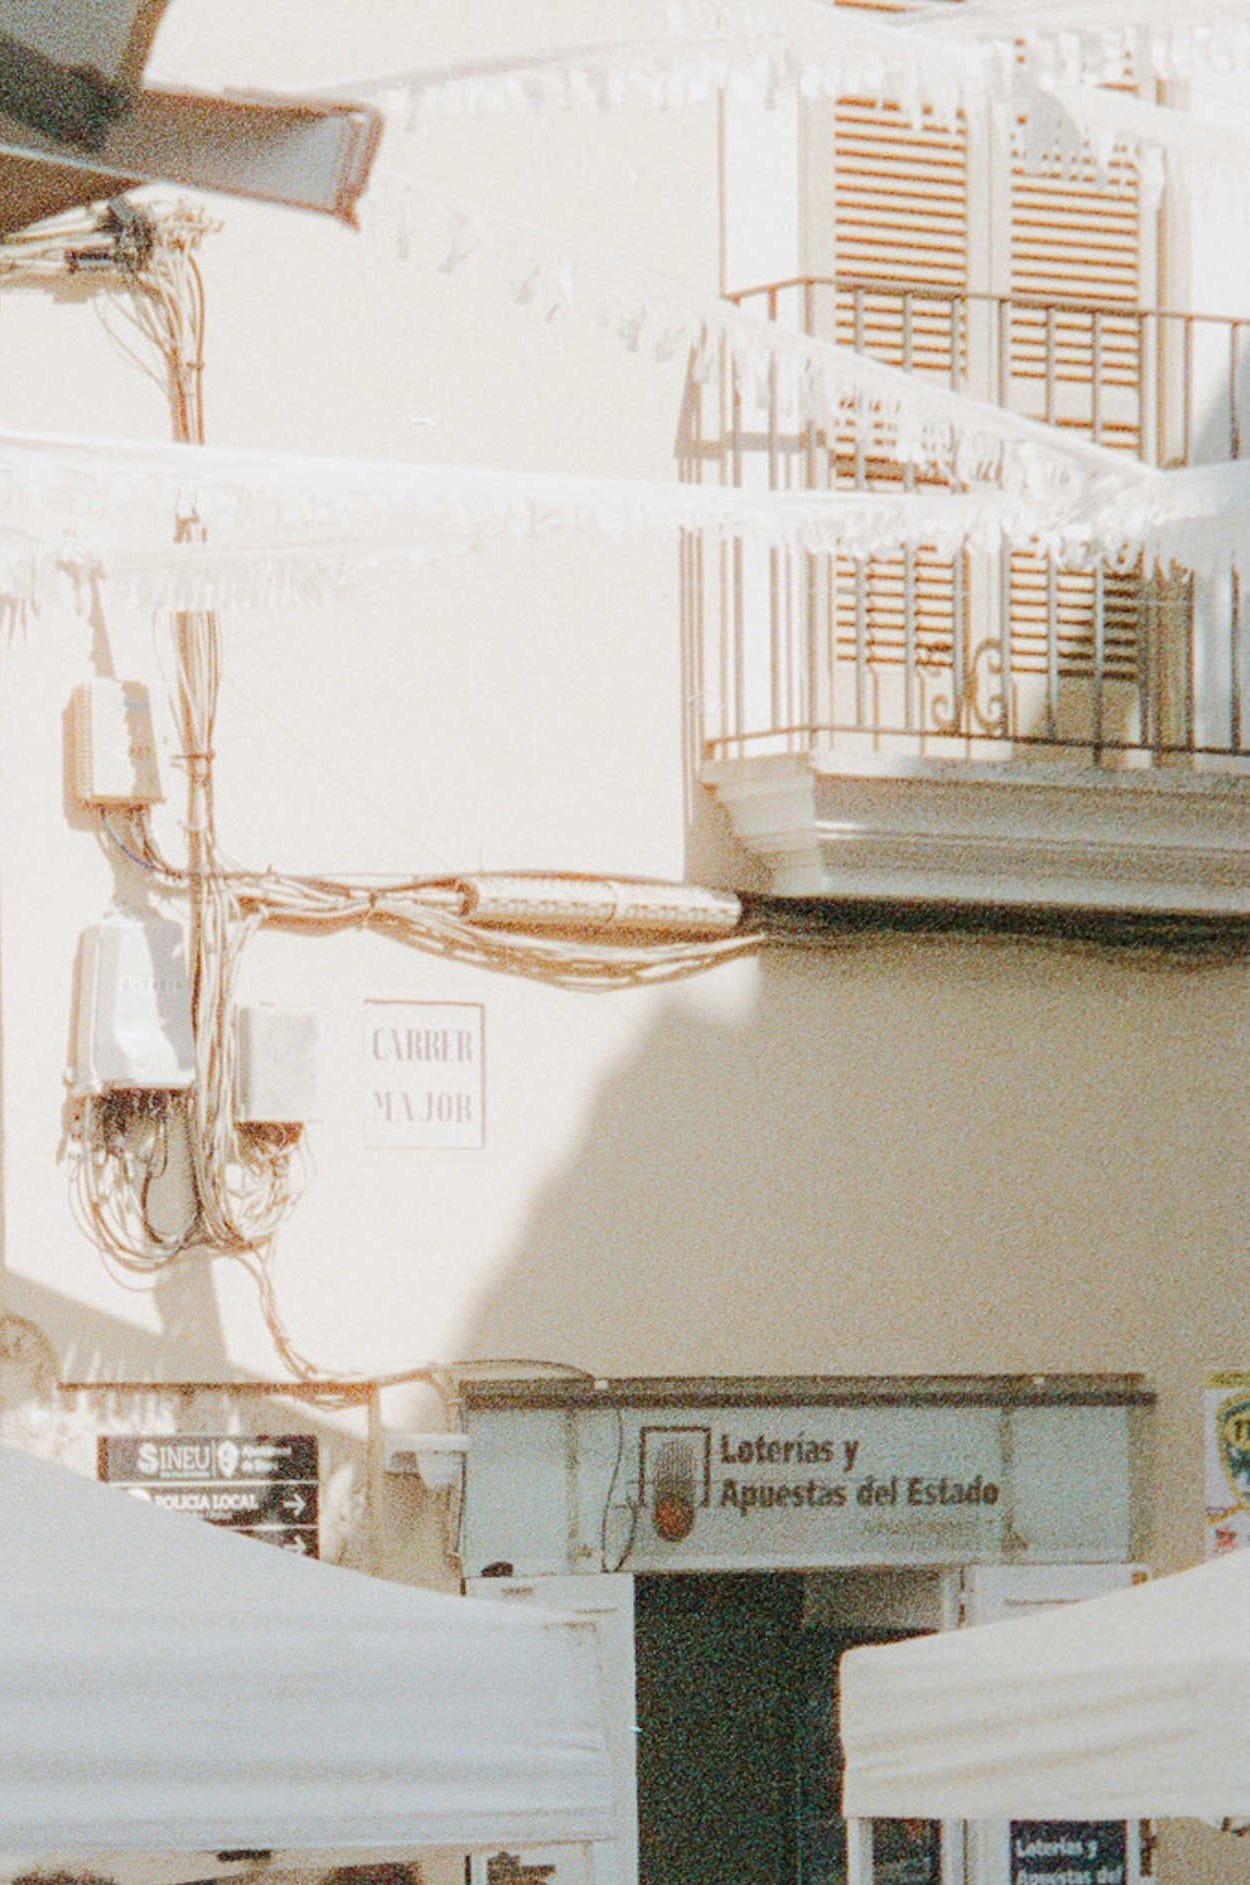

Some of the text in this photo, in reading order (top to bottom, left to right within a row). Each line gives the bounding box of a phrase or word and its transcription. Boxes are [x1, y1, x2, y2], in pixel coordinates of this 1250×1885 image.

[371, 1027, 473, 1063] CARRER
[372, 1090, 472, 1123] MAJOR
[136, 1442, 212, 1476] SINEU
[719, 1432, 860, 1471] Loterías y
[213, 1494, 259, 1511] LOCAL
[719, 1475, 1000, 1516] Apuestas del Estado
[1096, 1866, 1123, 1885] del
